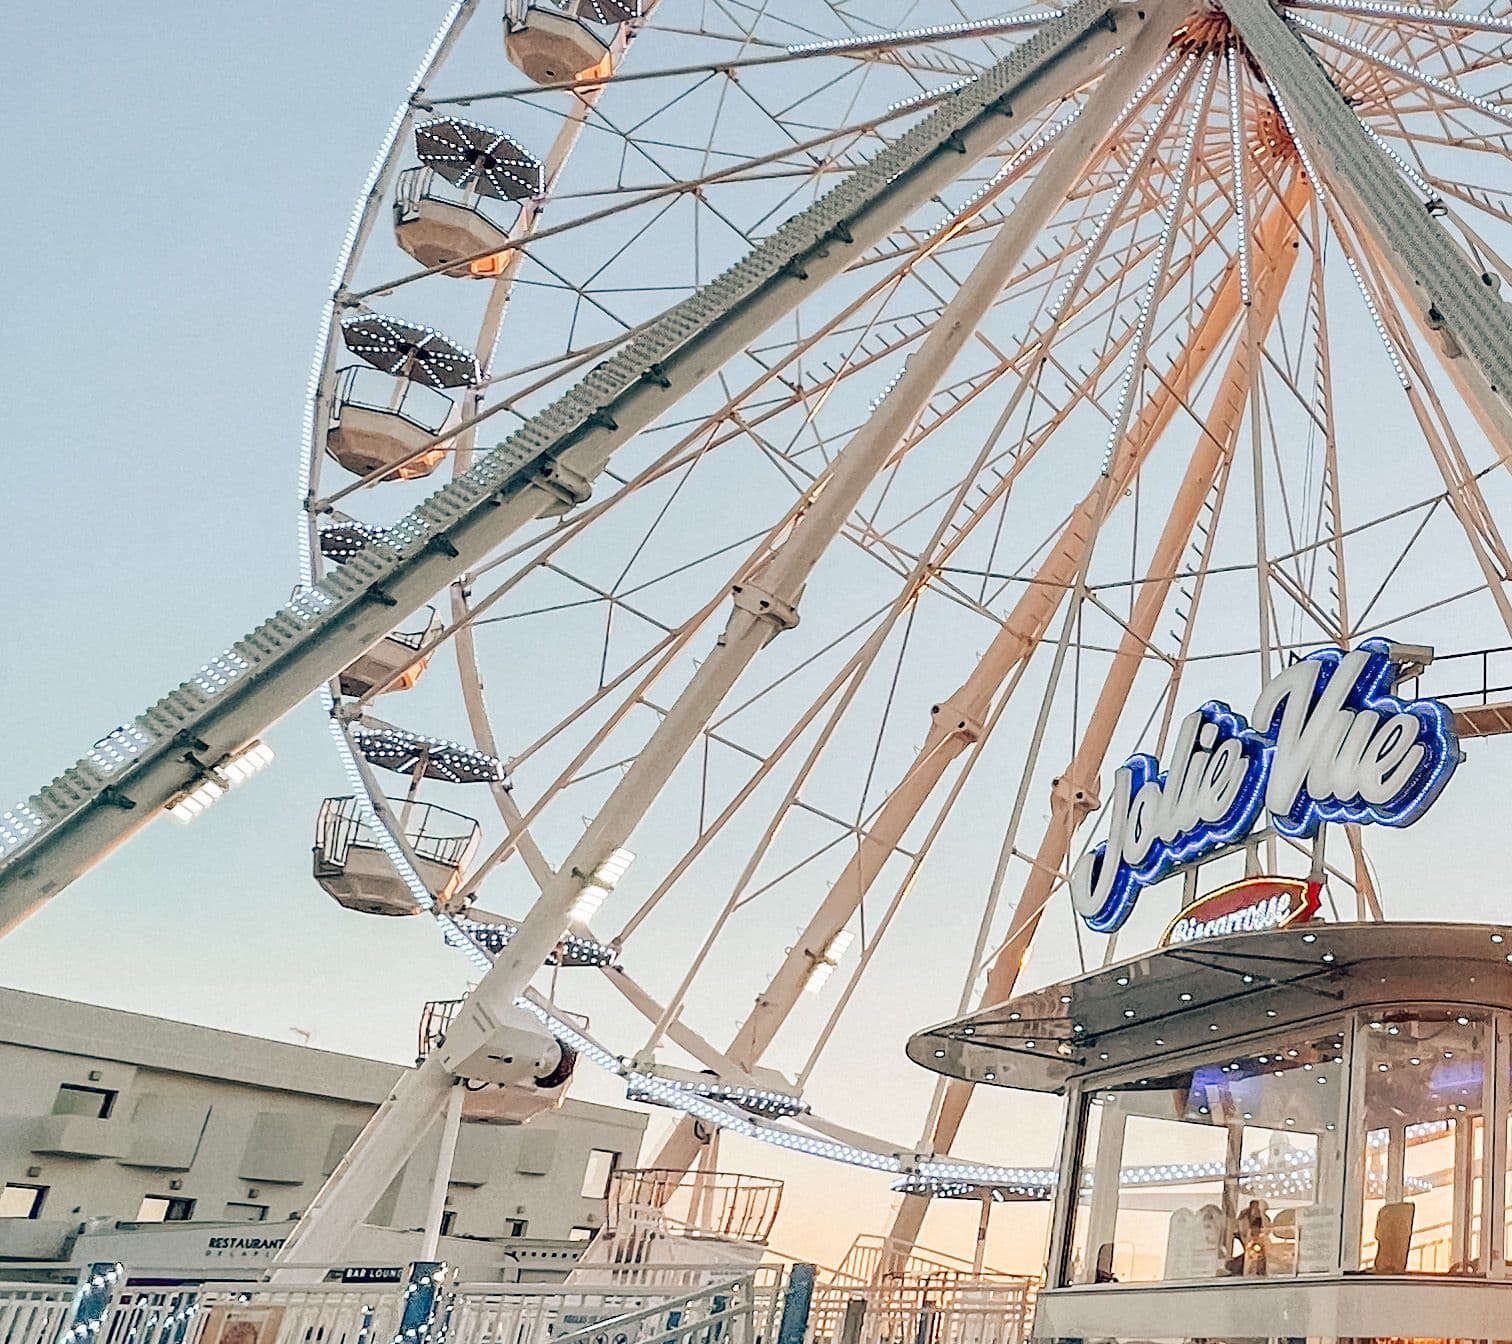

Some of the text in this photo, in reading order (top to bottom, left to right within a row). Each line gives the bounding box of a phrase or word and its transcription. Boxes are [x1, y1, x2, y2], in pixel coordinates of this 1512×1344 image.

[1072, 648, 1427, 917] Jolie Vue
[208, 1237, 286, 1249] RESTAURANT
[346, 1268, 367, 1278] BAR
